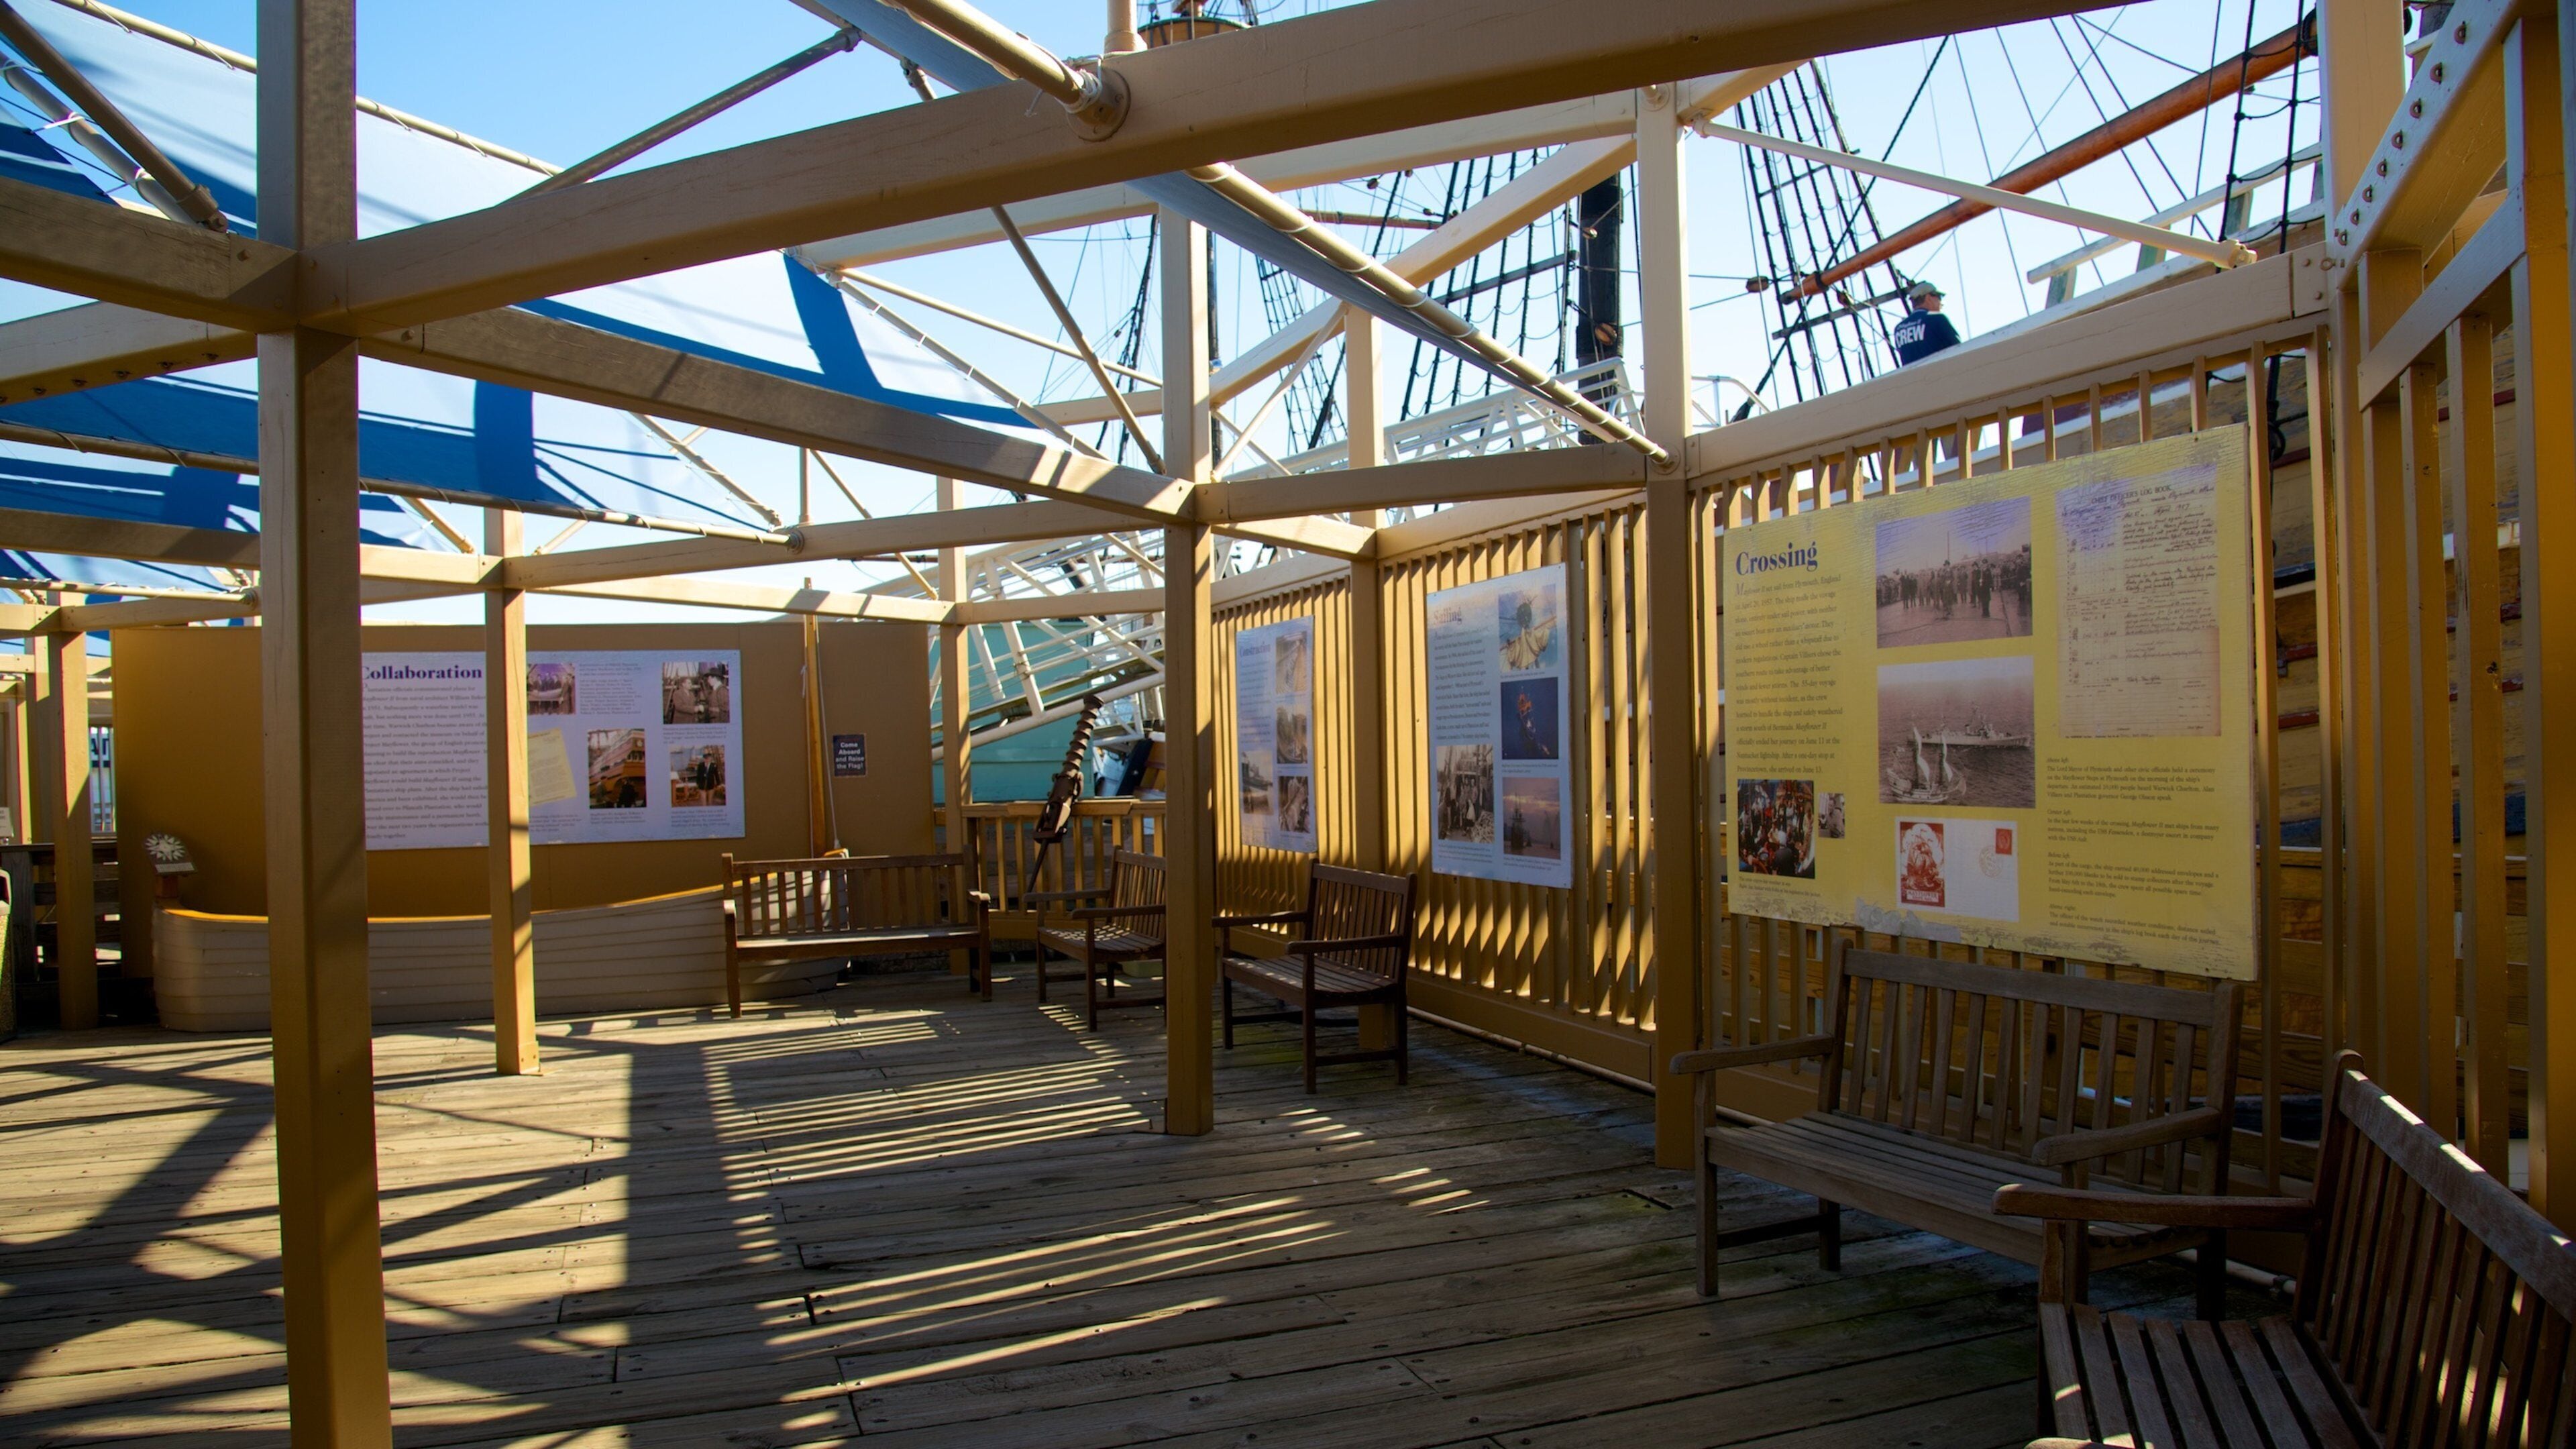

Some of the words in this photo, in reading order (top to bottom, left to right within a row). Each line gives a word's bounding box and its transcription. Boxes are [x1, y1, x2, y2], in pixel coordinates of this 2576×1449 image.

[1895, 324, 1925, 348] CREW
[2140, 488, 2152, 496] LOG
[2155, 485, 2171, 494] BOOK
[1735, 541, 1819, 576] Crossing
[1433, 606, 1462, 625] Sailing
[1239, 641, 1271, 657] Construction
